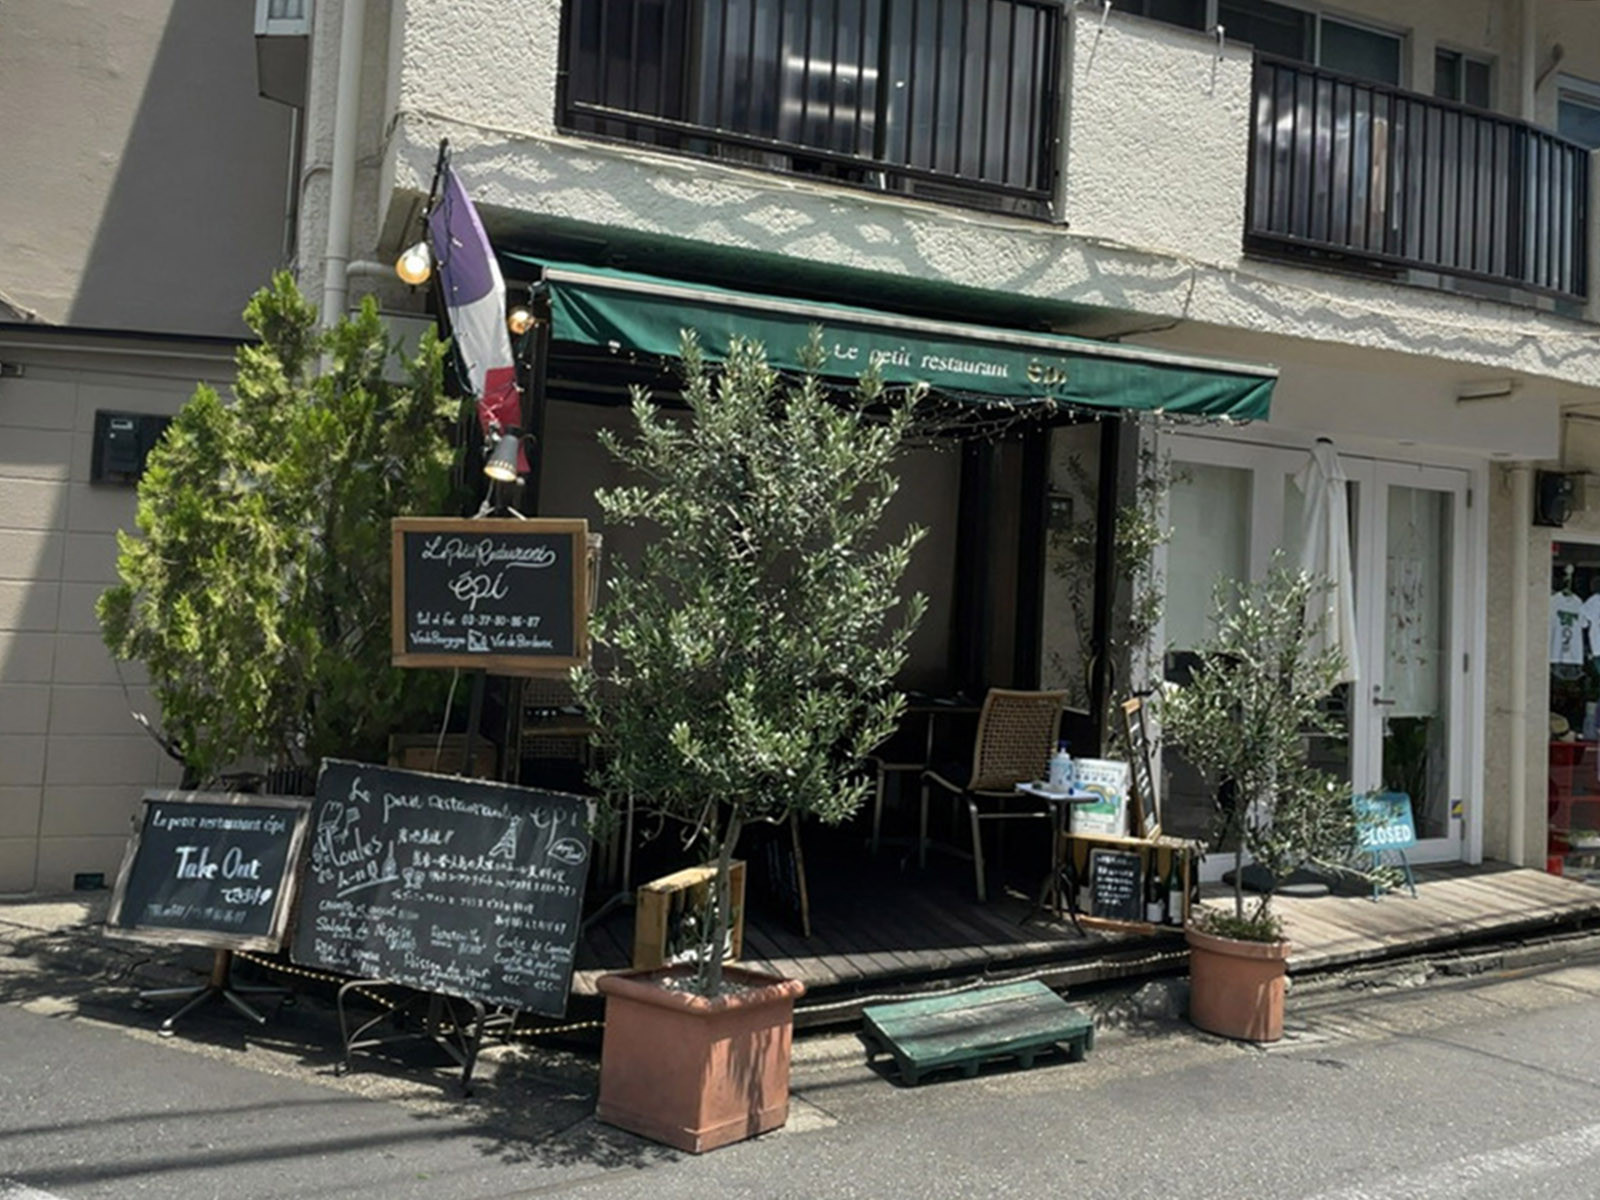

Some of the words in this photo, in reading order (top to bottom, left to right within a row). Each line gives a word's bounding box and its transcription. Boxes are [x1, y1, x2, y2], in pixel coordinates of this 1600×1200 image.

[869, 347, 911, 368] petit
[920, 355, 1009, 379] restaurant
[175, 846, 218, 880] Take
[221, 846, 262, 880] Out
